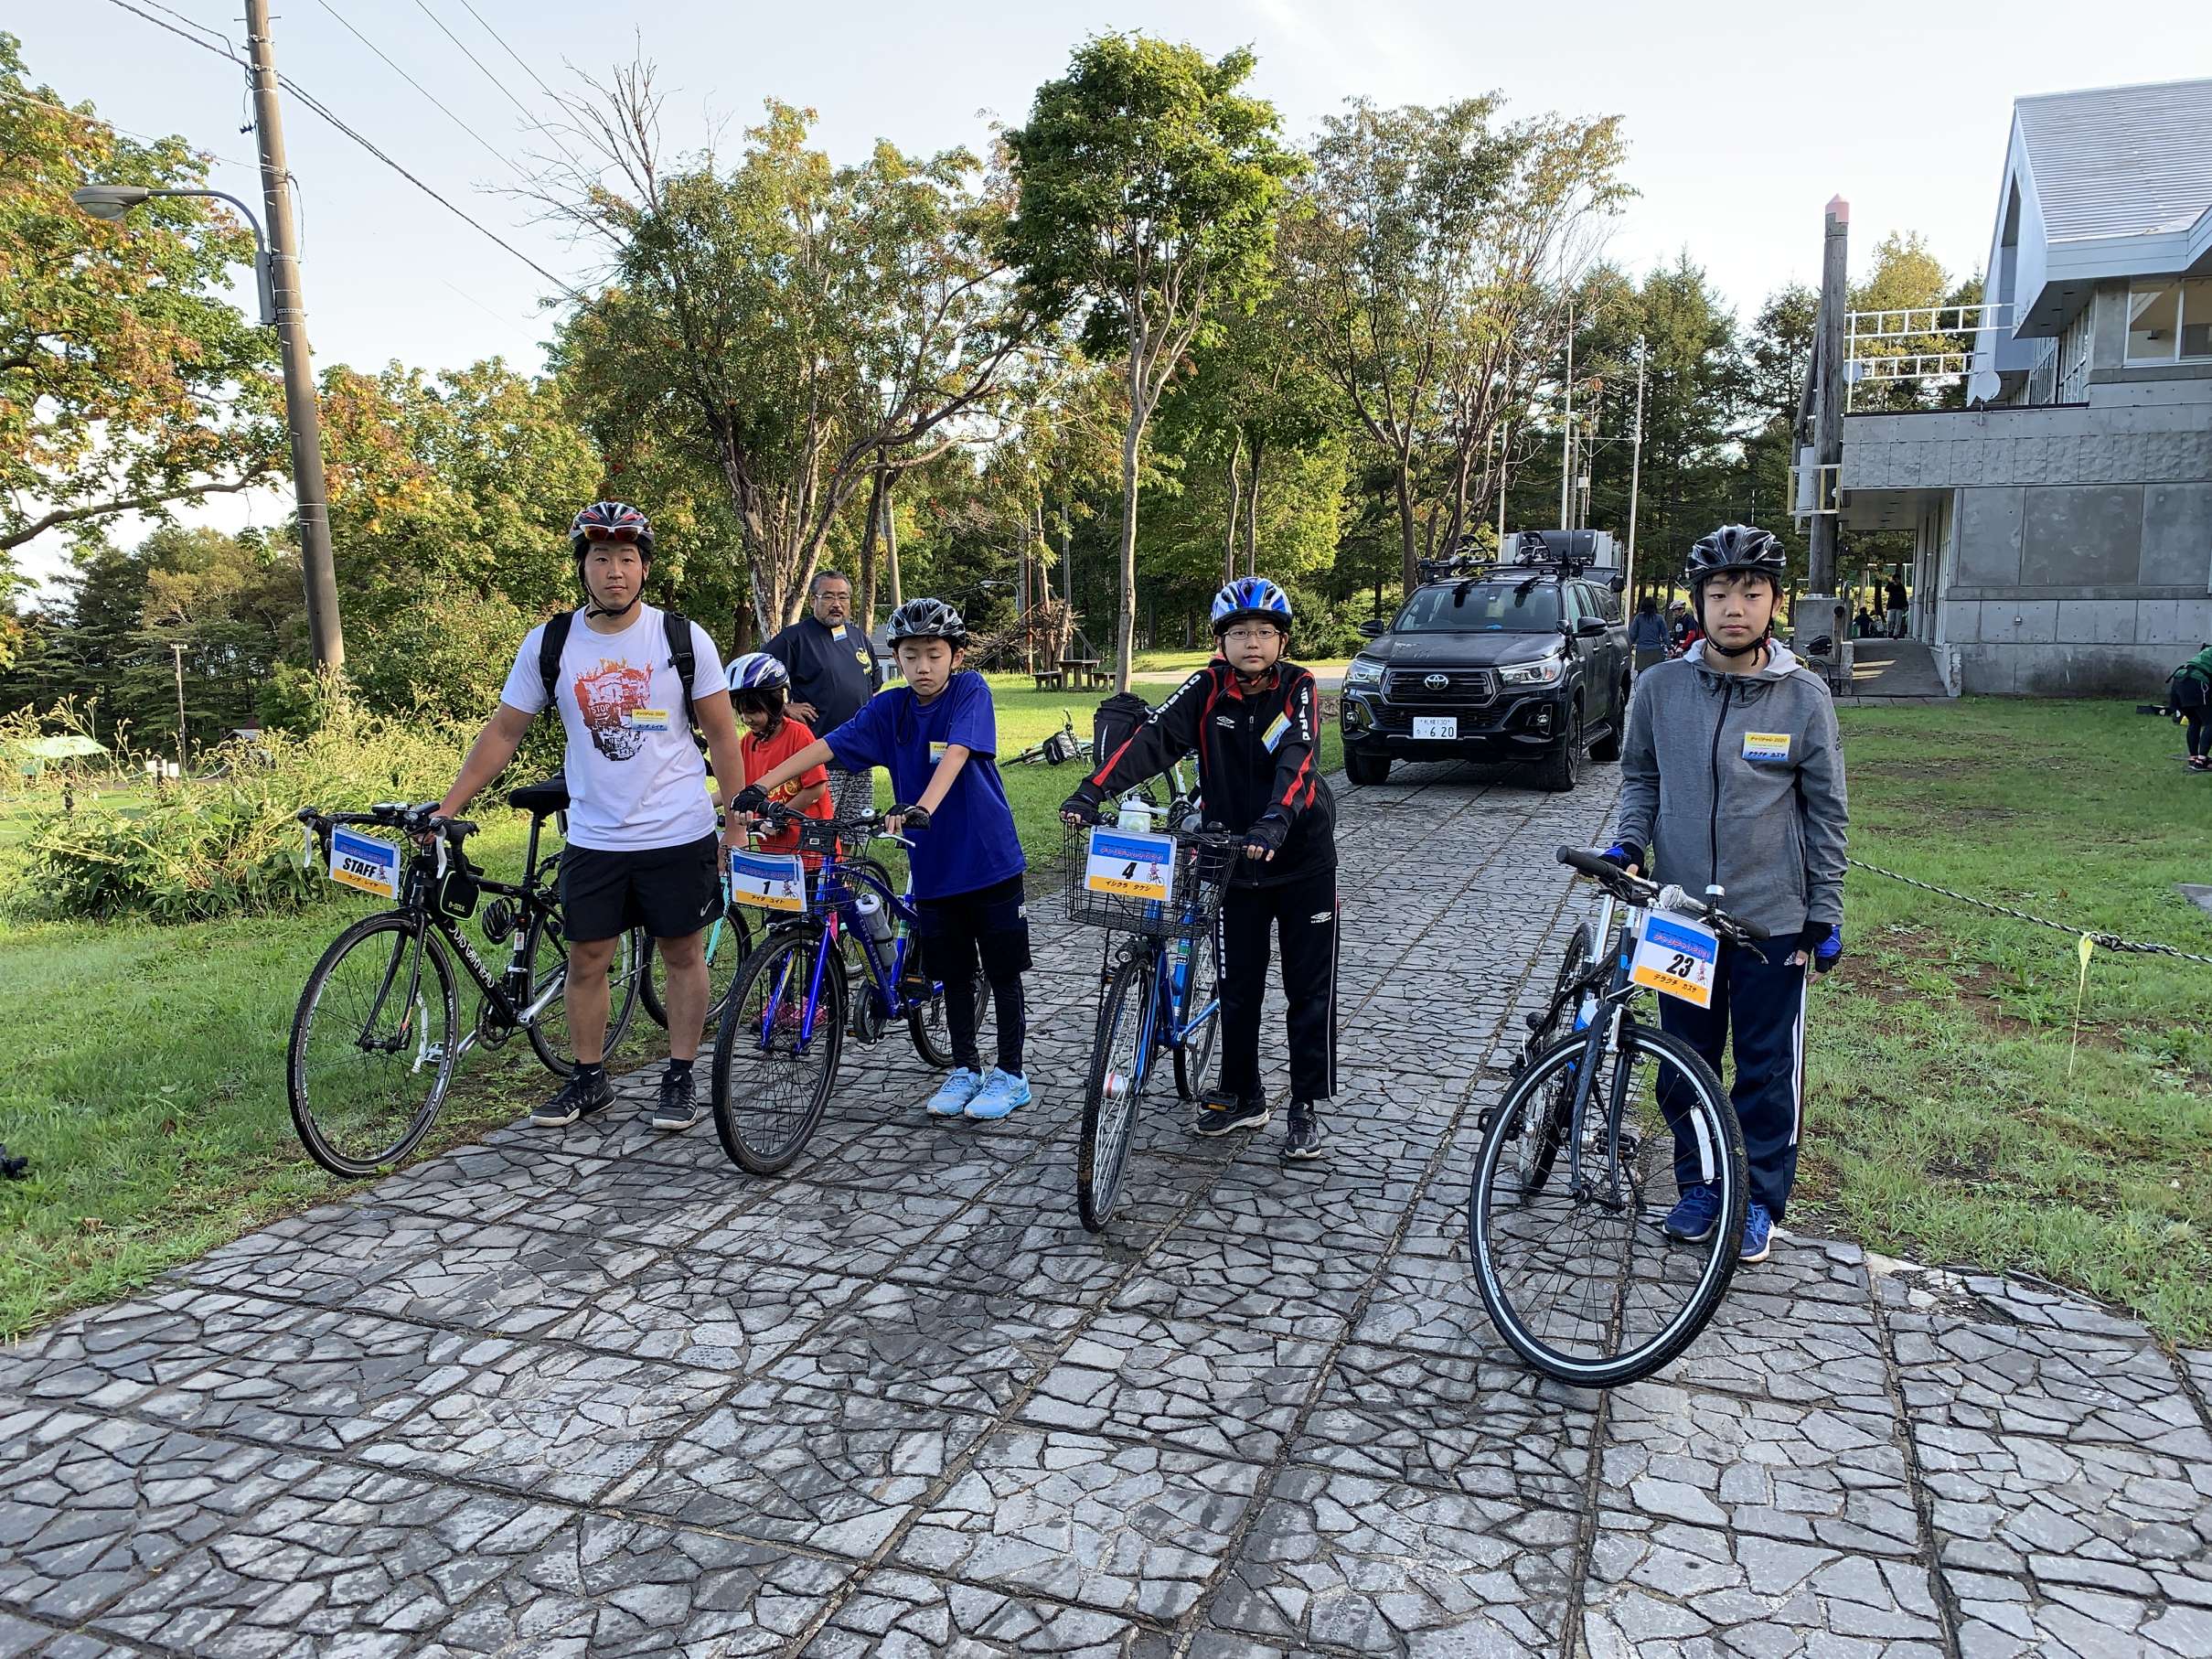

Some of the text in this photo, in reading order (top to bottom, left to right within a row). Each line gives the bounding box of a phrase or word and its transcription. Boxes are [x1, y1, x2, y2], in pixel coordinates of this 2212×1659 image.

[591, 703, 611, 713] STOP
[342, 857, 378, 878] STAFF
[1121, 862, 1138, 880] 4
[763, 880, 771, 895] 1
[465, 943, 495, 988] GARNEAU
[1666, 953, 1694, 979] 23
